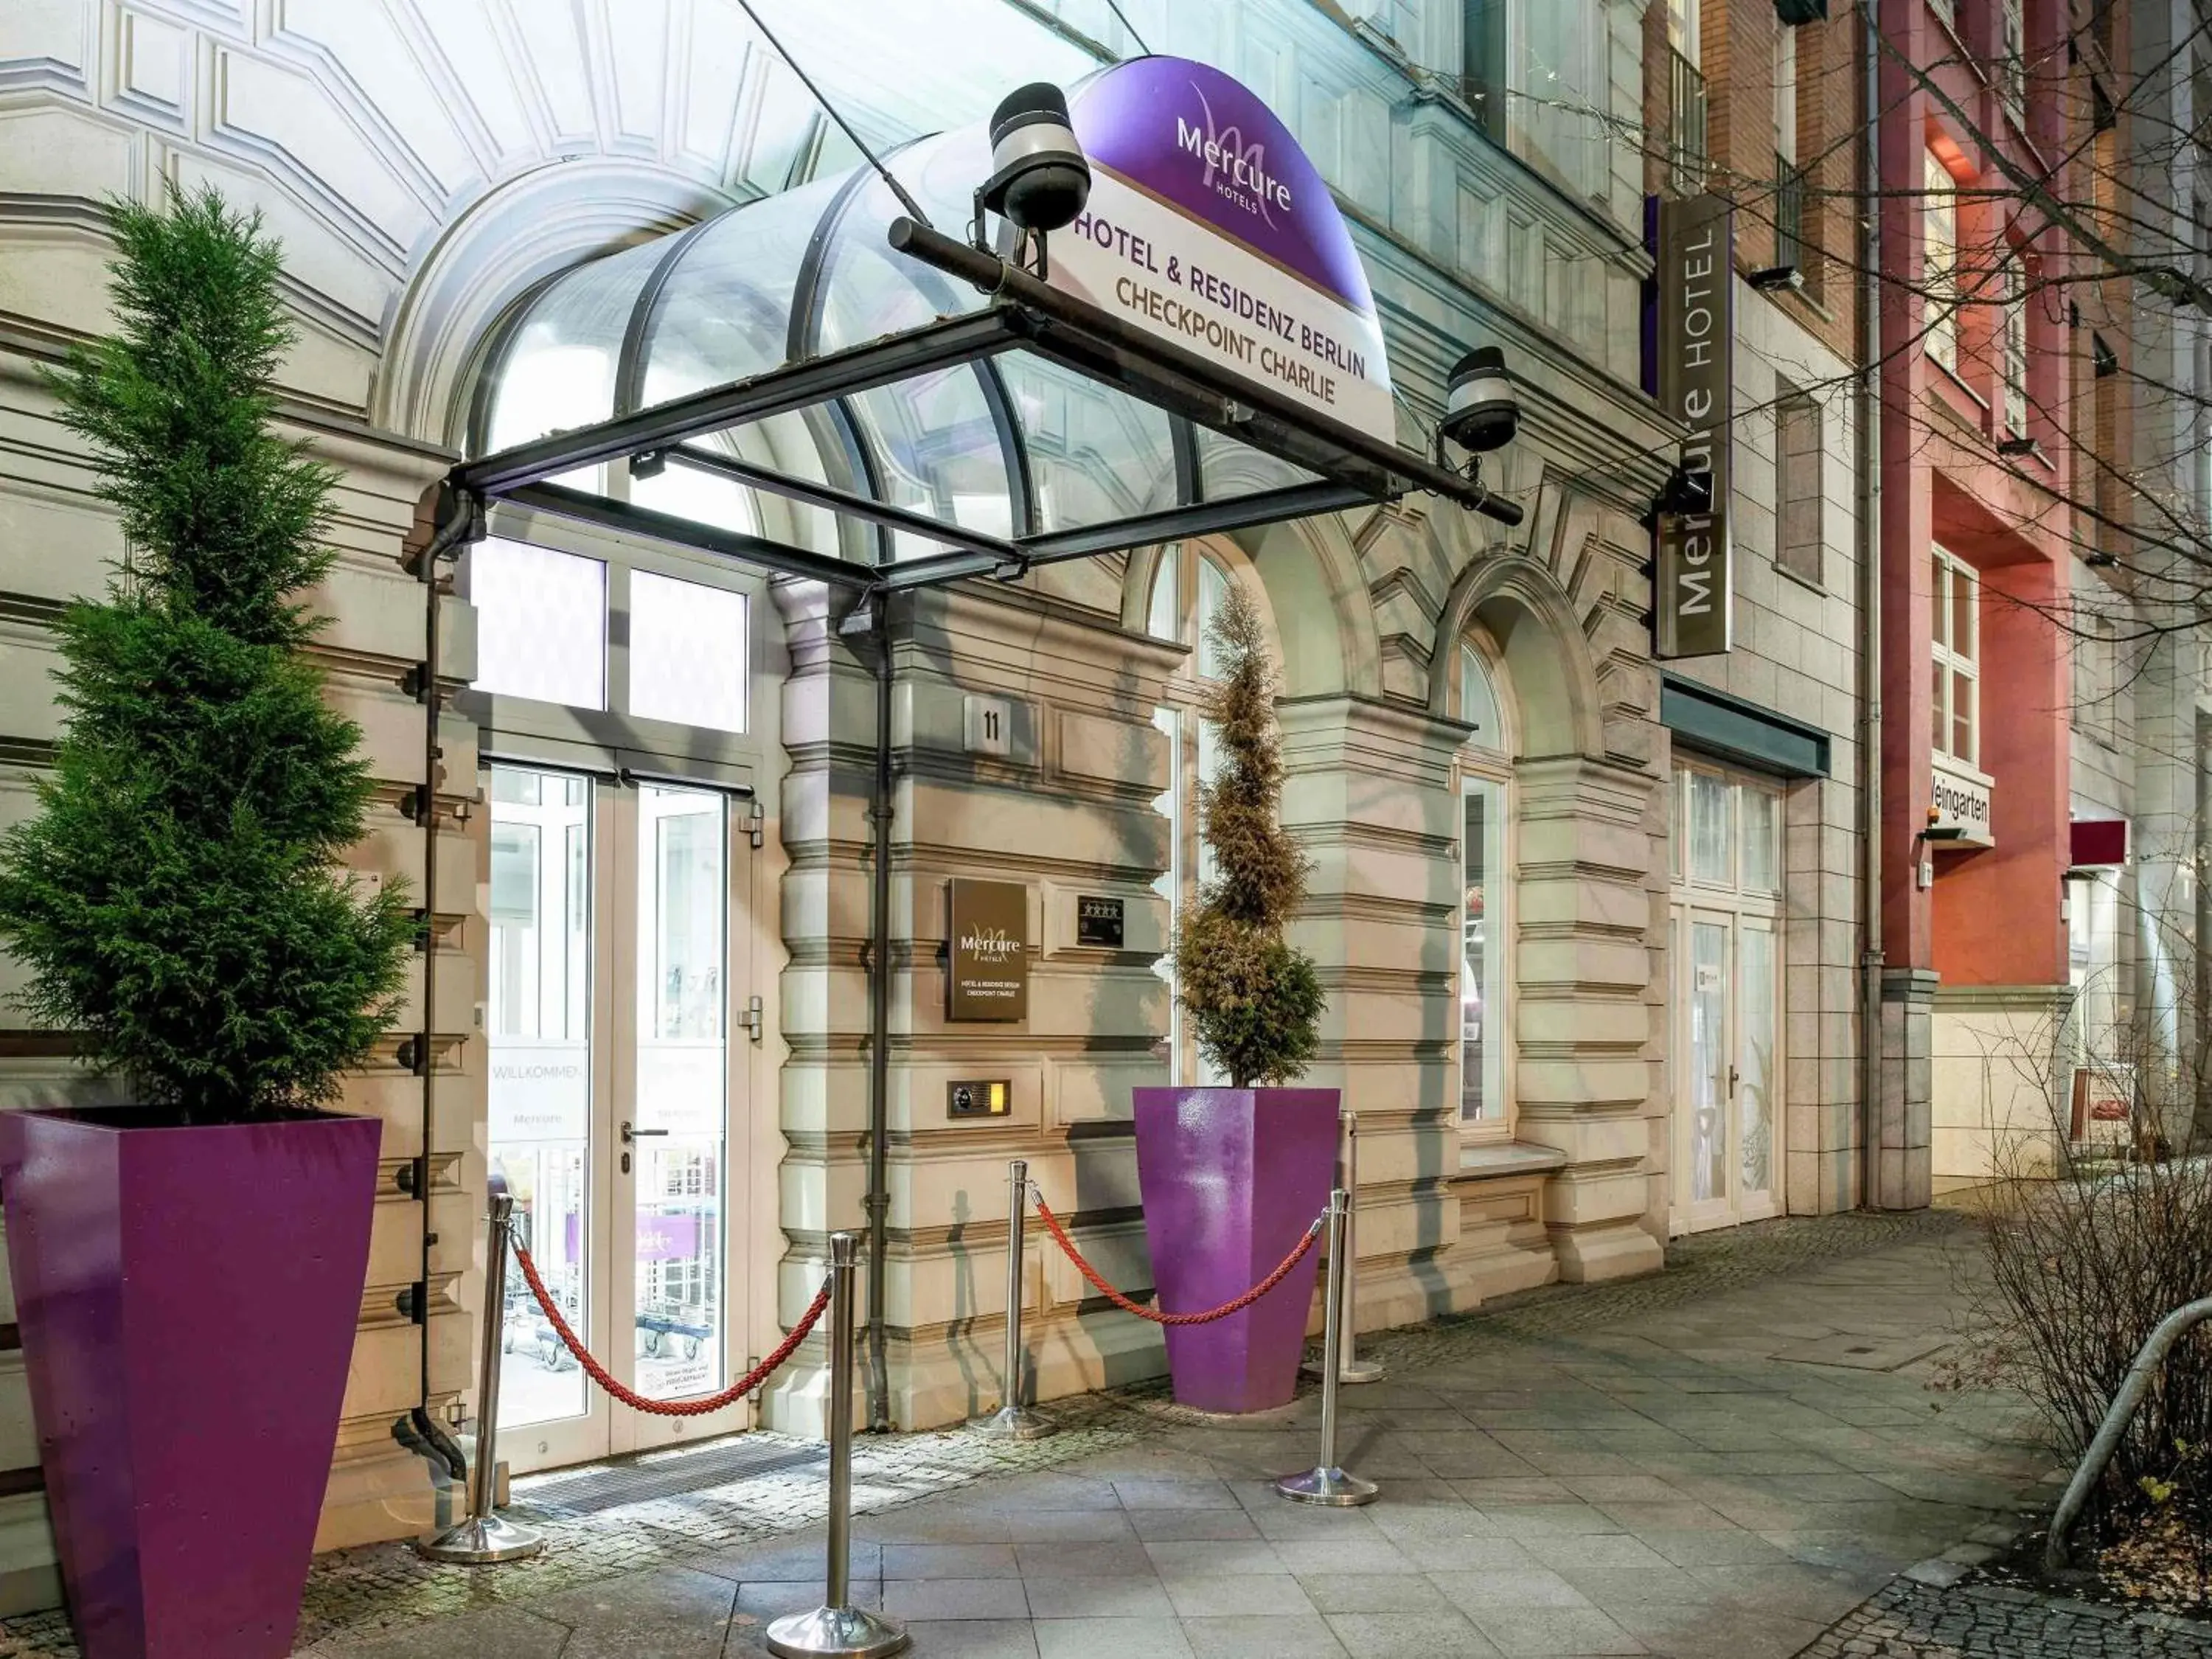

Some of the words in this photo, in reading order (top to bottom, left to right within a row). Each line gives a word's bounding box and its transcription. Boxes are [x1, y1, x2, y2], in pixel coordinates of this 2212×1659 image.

[1178, 116, 1291, 211] Mercure
[1217, 181, 1257, 214] HOTELS
[1074, 212, 1158, 274] HOTEL
[1166, 256, 1181, 285] &
[1191, 265, 1295, 343] RESIDENZ
[1301, 324, 1365, 380] BERLIN
[1116, 276, 1255, 364] CHECKPOINT
[1260, 347, 1335, 405] CHARLIE
[1685, 229, 1712, 368] HOTEL
[1679, 388, 1712, 616] Merure
[984, 710, 999, 741] 11
[1932, 775, 1987, 823] eingarten
[961, 935, 1020, 952] Mercure
